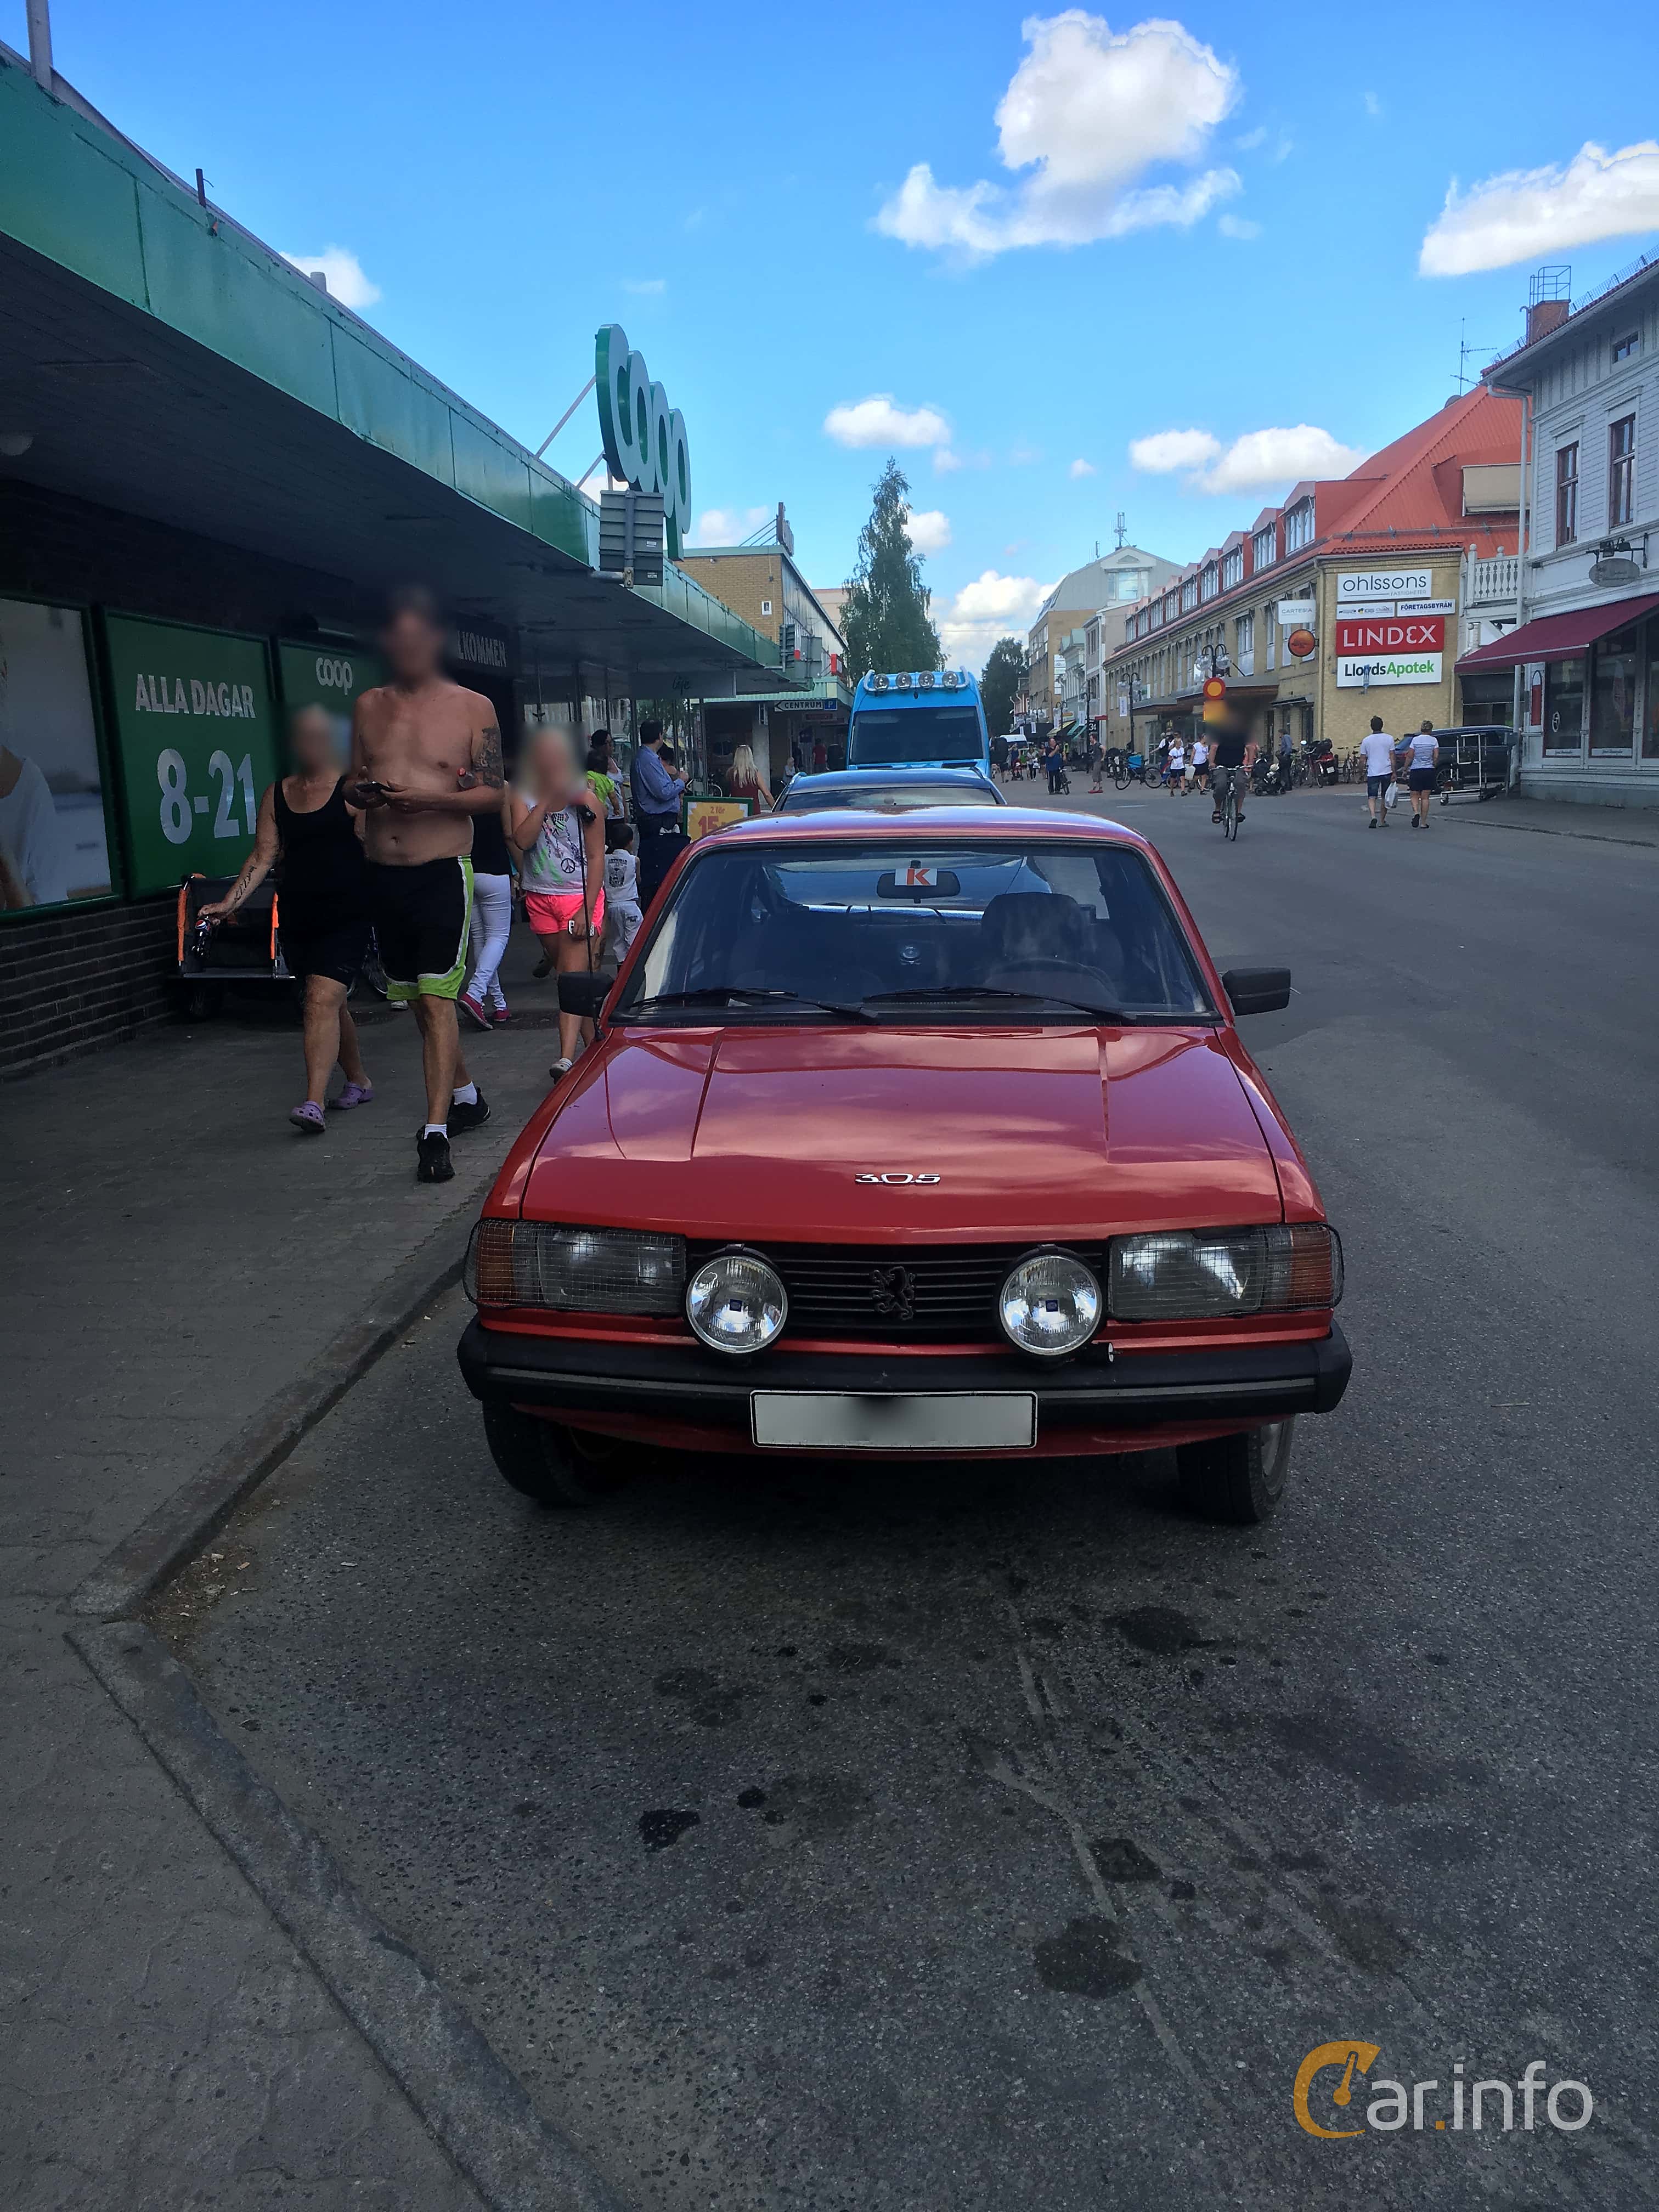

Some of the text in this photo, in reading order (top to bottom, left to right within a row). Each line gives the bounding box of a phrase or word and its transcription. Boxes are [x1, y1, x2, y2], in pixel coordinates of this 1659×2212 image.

[595, 324, 691, 561] coop
[1343, 575, 1426, 591] ohlssons
[1401, 601, 1452, 610] FÖRETAGSBYRÅN
[1344, 625, 1436, 647] LINDEX
[316, 657, 353, 695] coop
[136, 674, 256, 719] ALLA DAGAR
[157, 748, 257, 844] 8-21
[907, 869, 930, 885] K
[855, 1173, 941, 1184] 305
